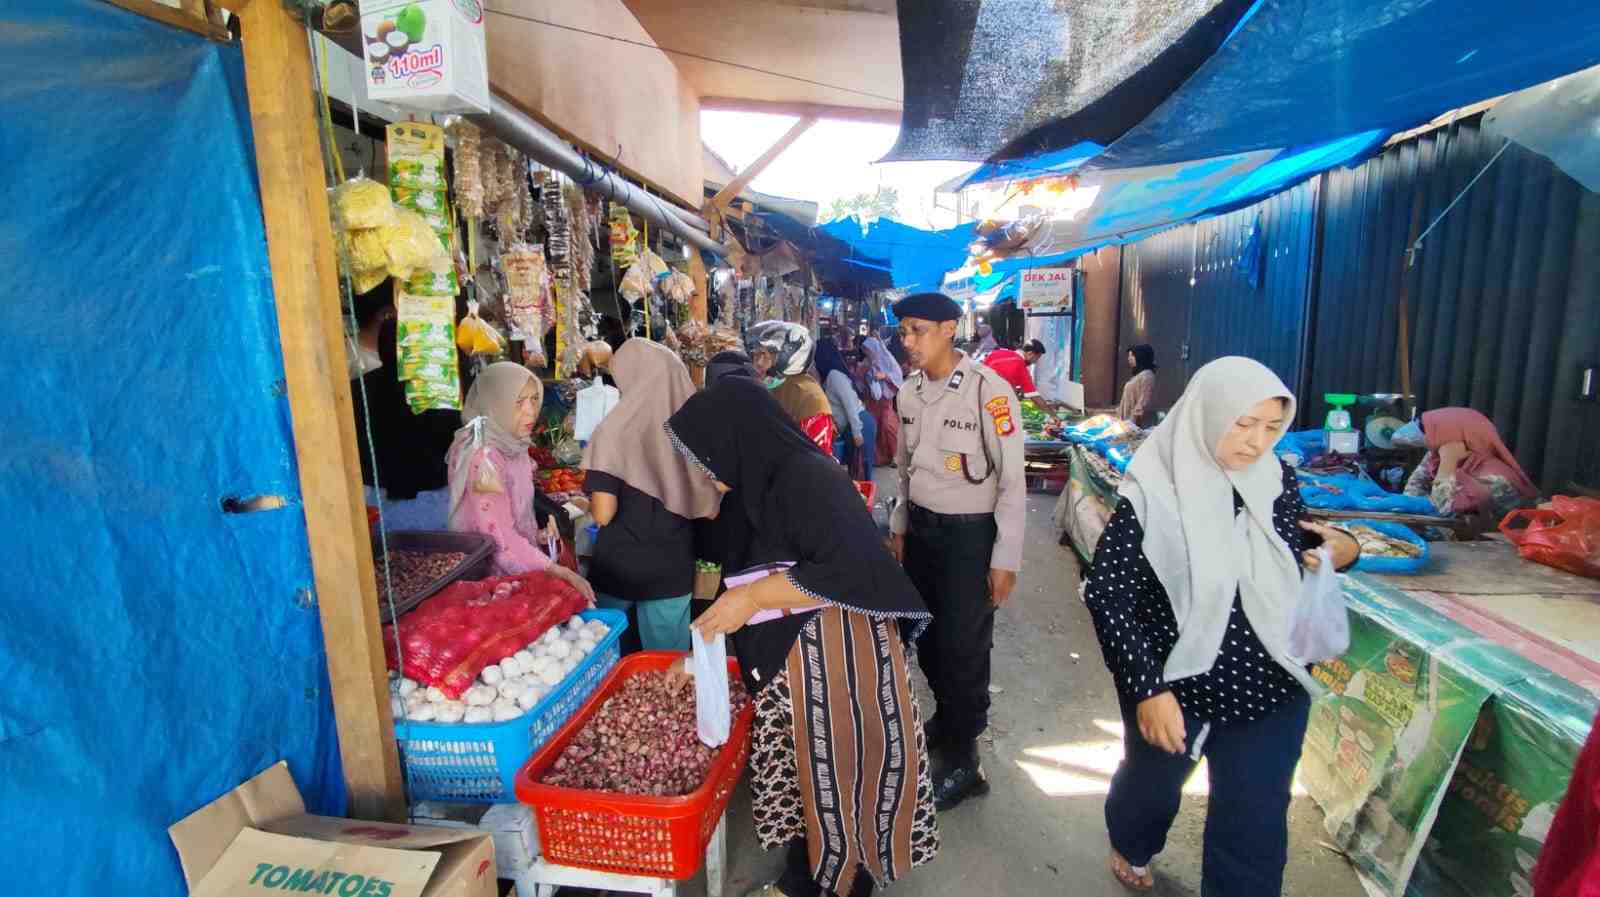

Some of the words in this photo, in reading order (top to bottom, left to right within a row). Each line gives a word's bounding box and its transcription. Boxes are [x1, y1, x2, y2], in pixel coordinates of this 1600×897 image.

[390, 46, 441, 78] 110ml
[943, 419, 977, 431] POLRI
[249, 862, 395, 897] TOMATOES
